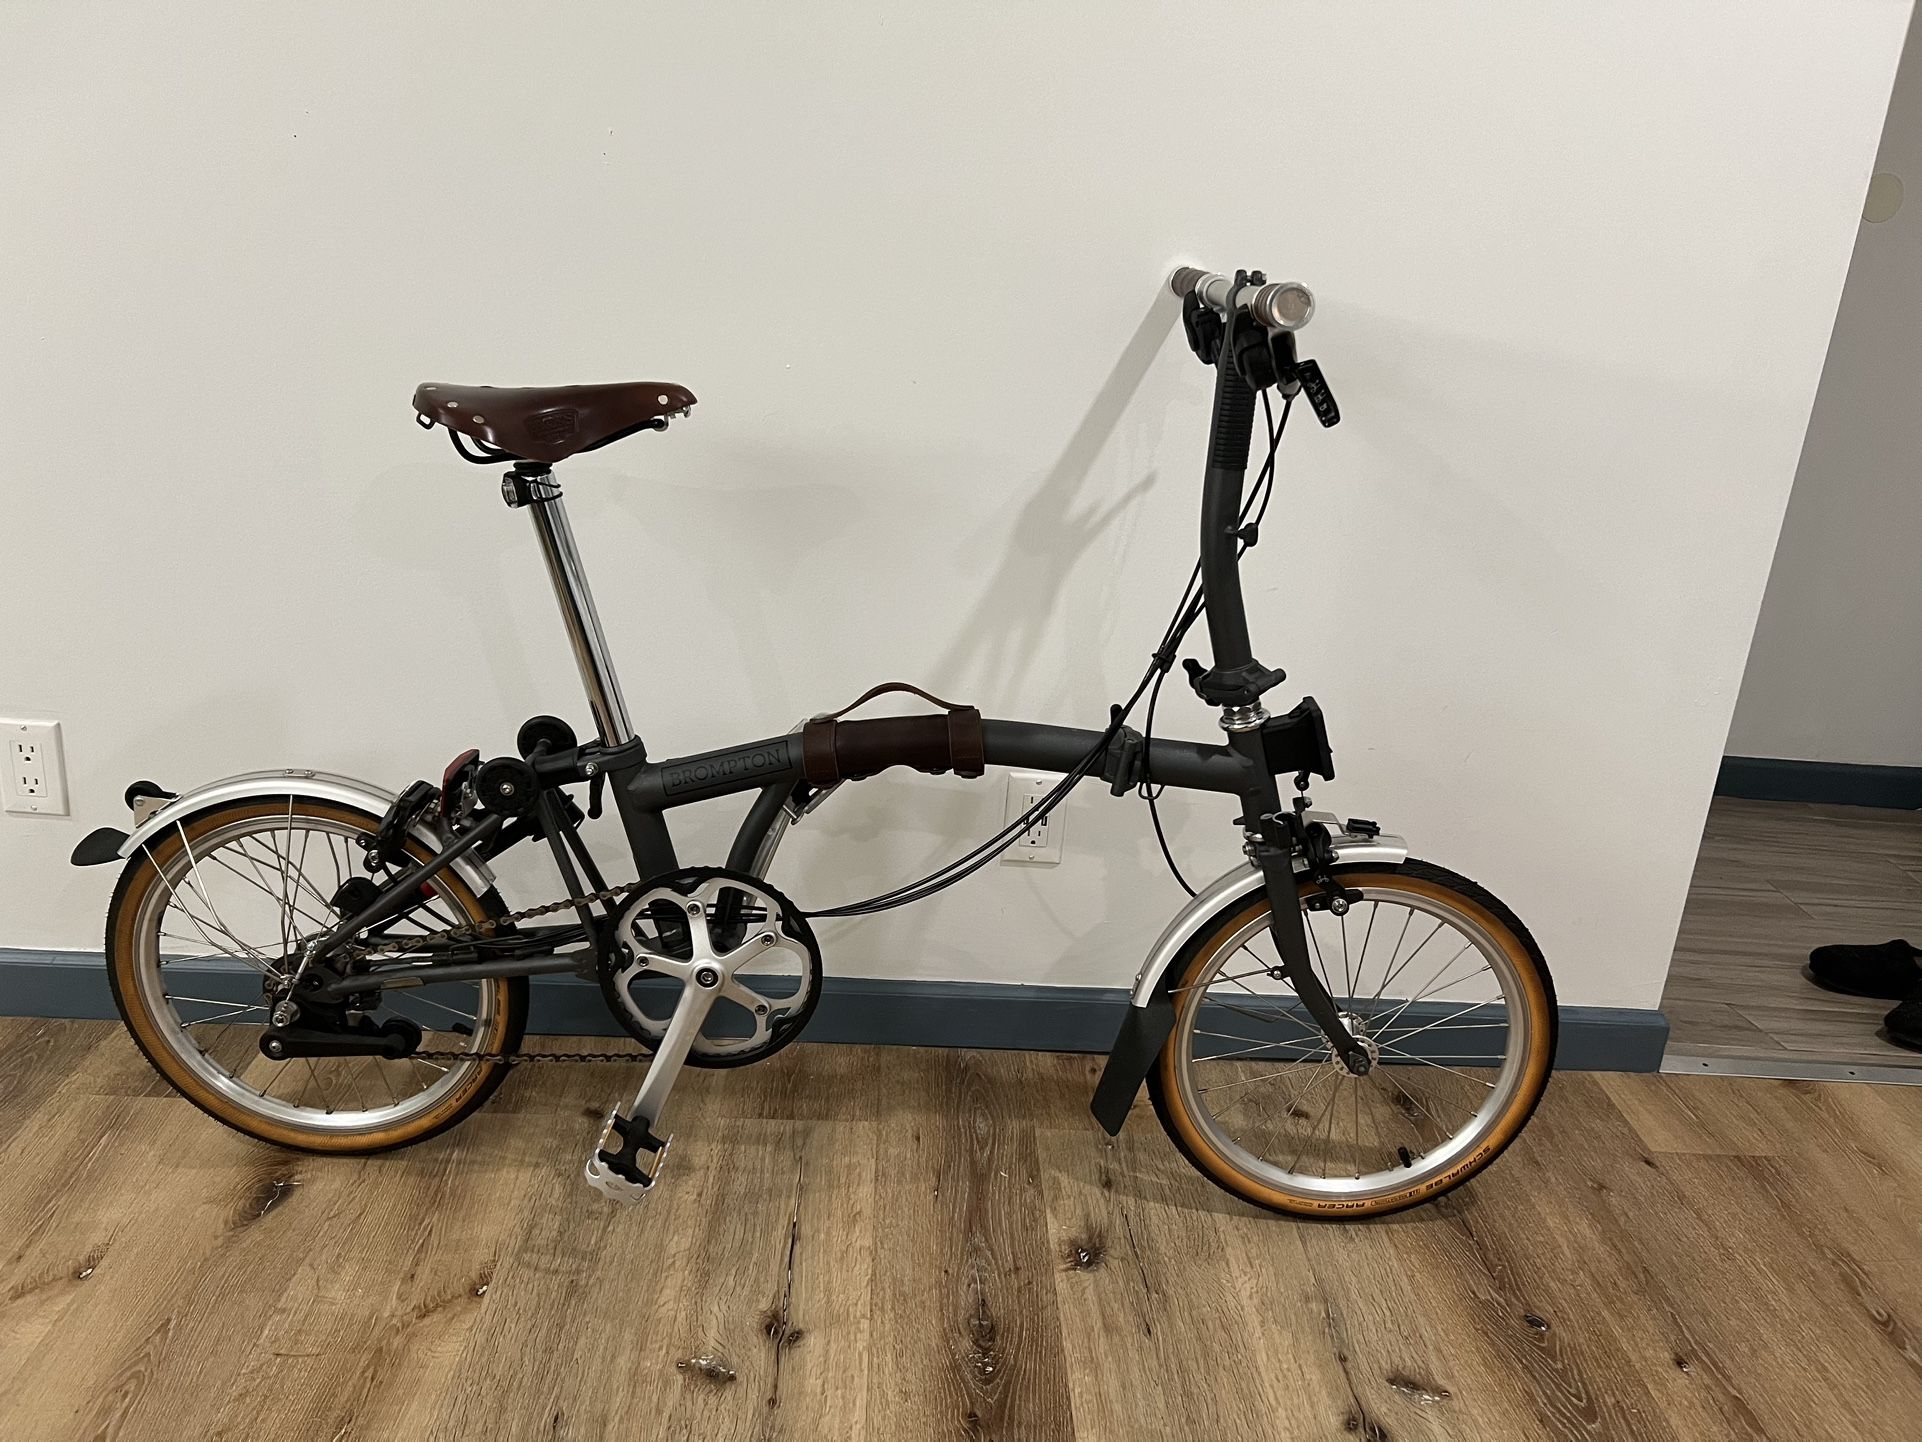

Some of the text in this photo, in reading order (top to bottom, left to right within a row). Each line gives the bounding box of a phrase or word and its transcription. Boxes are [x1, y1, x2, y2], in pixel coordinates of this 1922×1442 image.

[670, 748, 781, 788] BROMPTON
[1425, 1145, 1492, 1191] SCHWALBE
[1317, 1202, 1366, 1210] RACER
